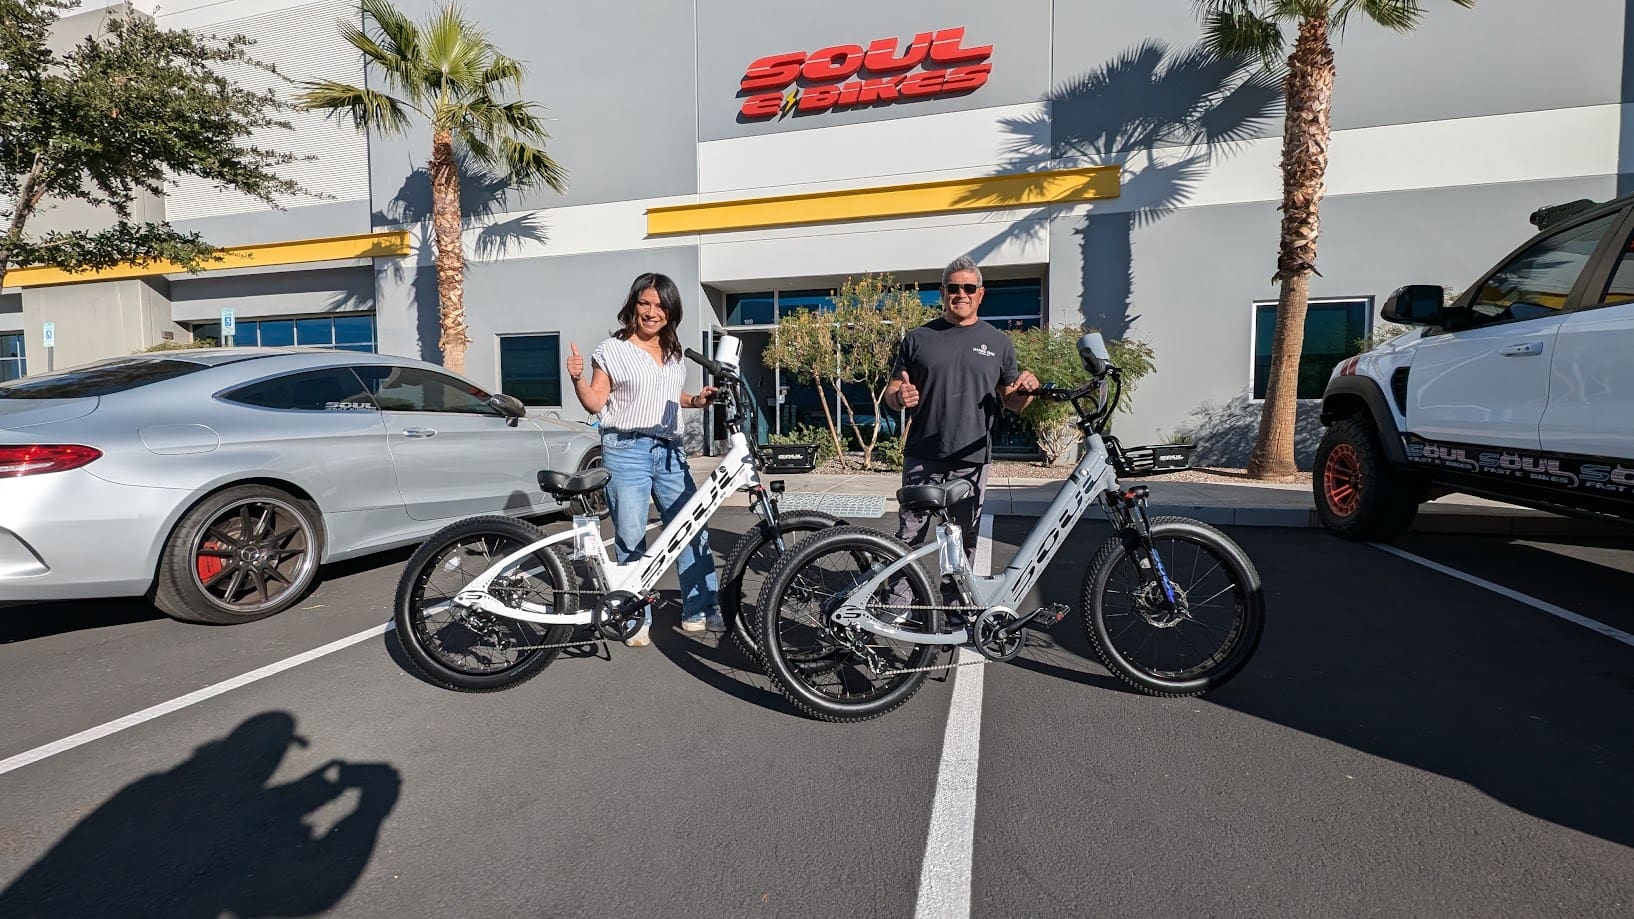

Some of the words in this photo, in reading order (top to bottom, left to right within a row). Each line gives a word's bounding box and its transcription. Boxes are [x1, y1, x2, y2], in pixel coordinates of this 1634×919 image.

[740, 26, 993, 91] SOUL
[324, 401, 377, 409] SOUL
[1406, 443, 1479, 472] SOUL
[1479, 451, 1579, 488] SOUL
[640, 463, 746, 588] SOUL
[1011, 465, 1107, 602] SOUL
